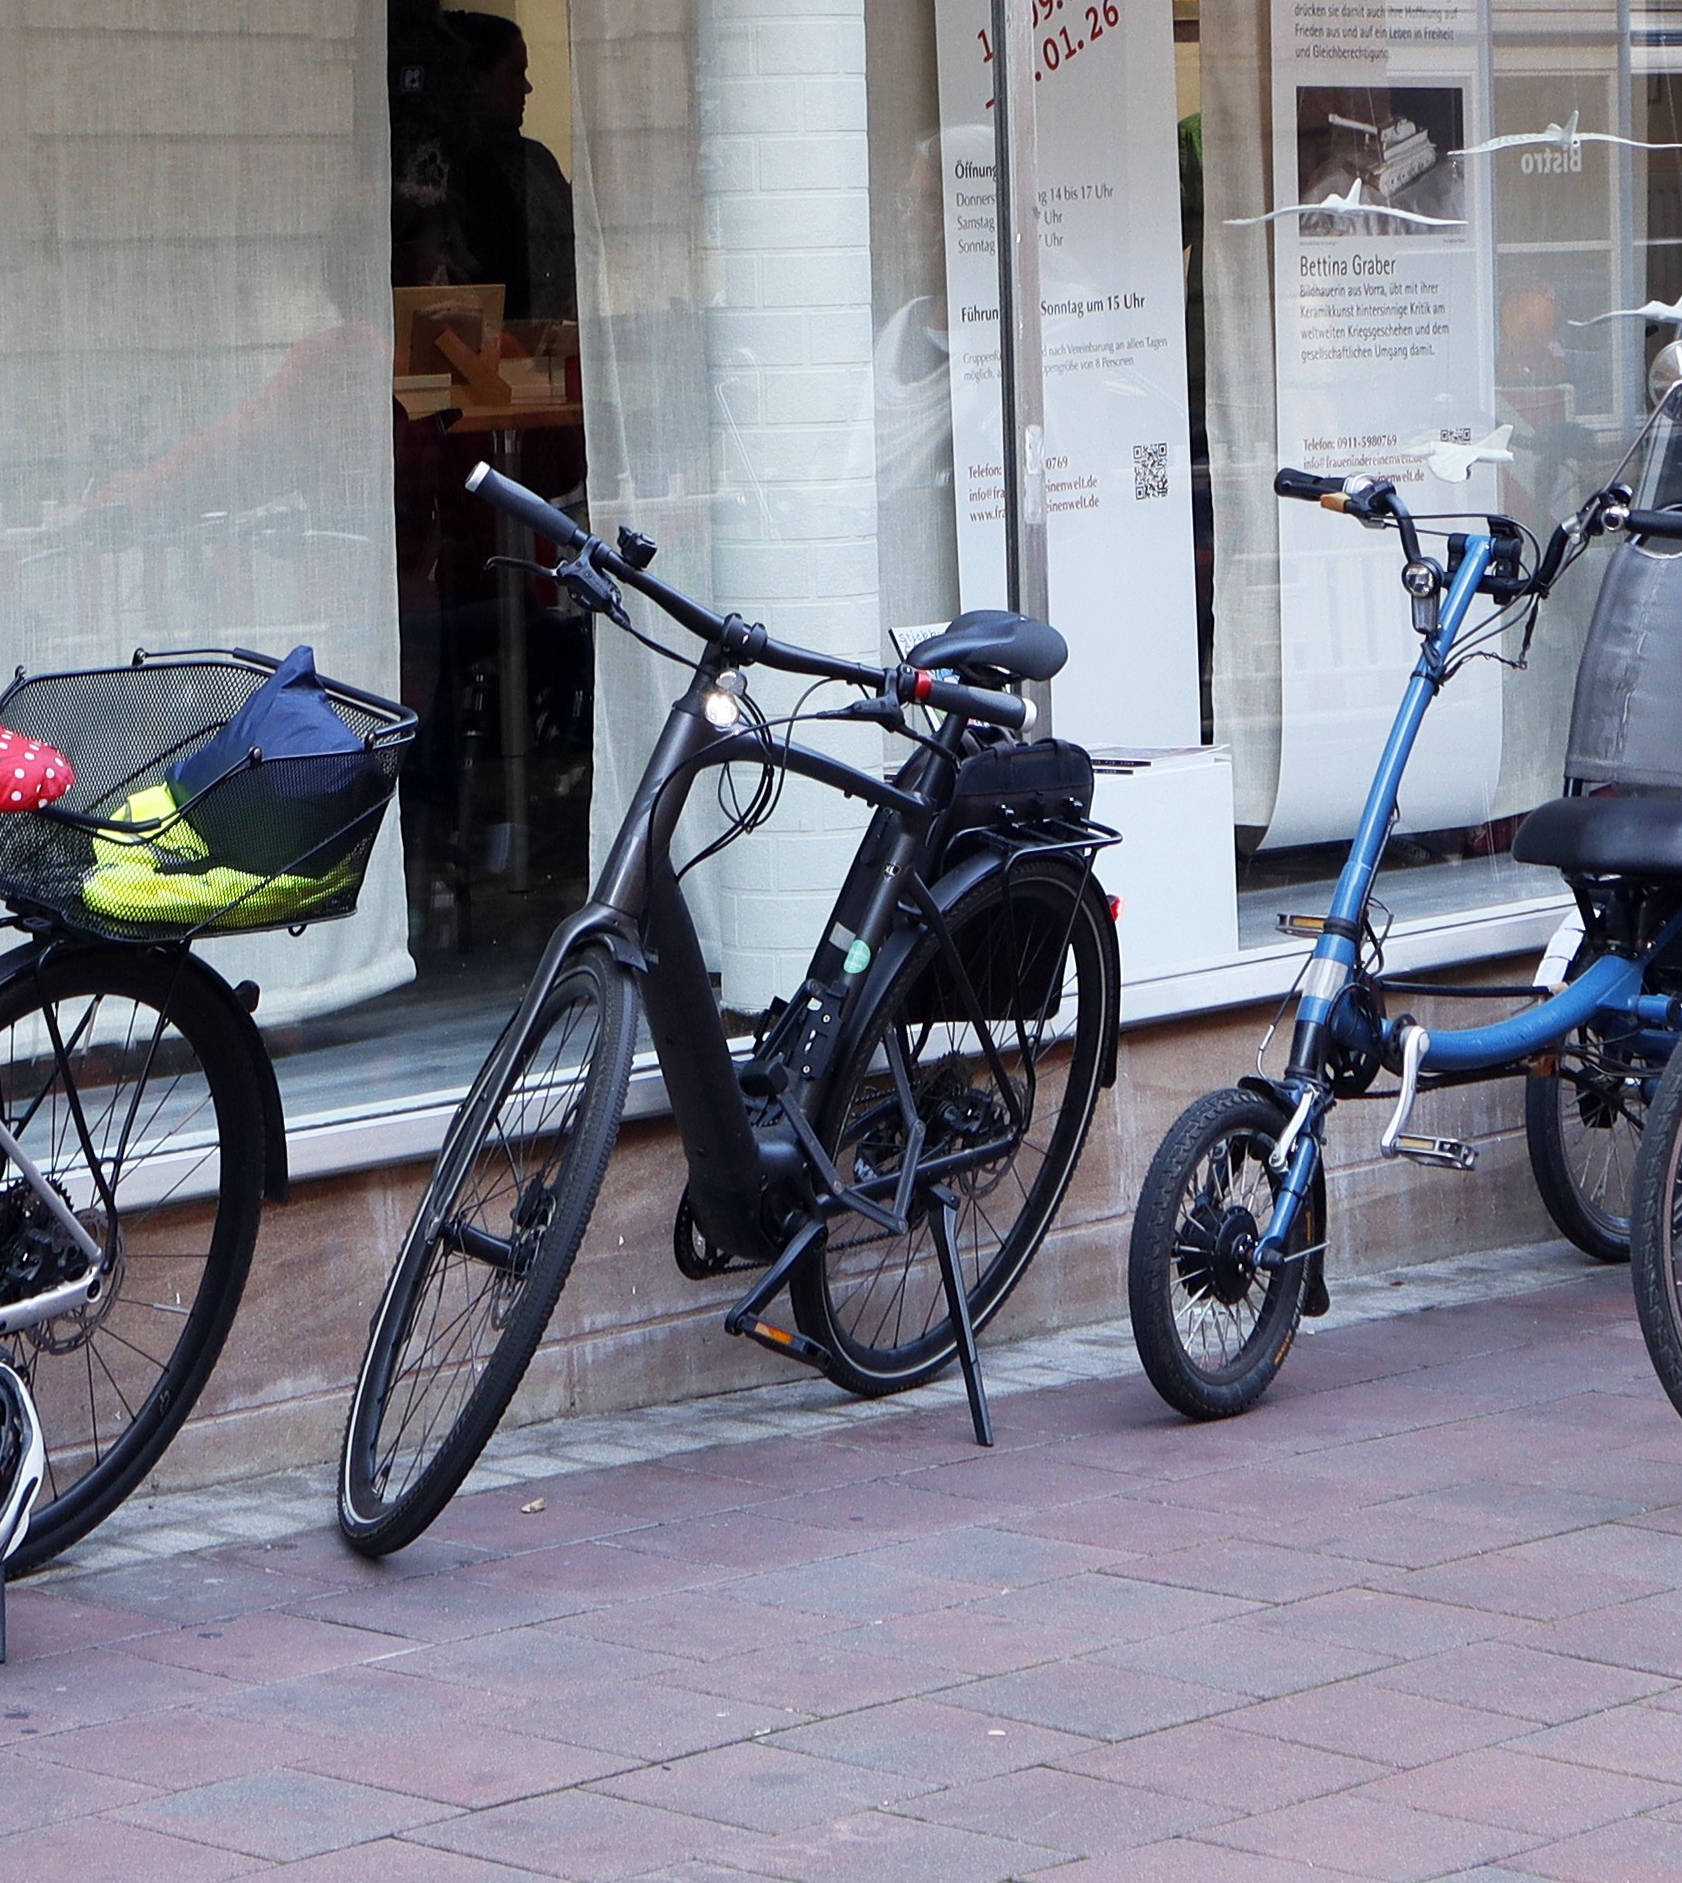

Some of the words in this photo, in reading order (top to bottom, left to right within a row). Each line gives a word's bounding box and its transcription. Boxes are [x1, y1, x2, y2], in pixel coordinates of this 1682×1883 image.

[1050, 189, 1061, 201] 14
[1064, 188, 1078, 200] bis
[1081, 186, 1093, 199] 17
[1096, 185, 1114, 198] Uhr
[958, 217, 995, 231] Samstag
[1044, 211, 1062, 224] Uhr
[958, 240, 995, 254] Sonntag
[1045, 234, 1064, 247] Uhr
[1300, 255, 1348, 277] Bettina
[1353, 254, 1396, 276] Graber
[1040, 299, 1083, 318] Sonntag
[1087, 301, 1104, 312] um
[1107, 296, 1120, 311] 15
[1124, 294, 1145, 310] Uhr
